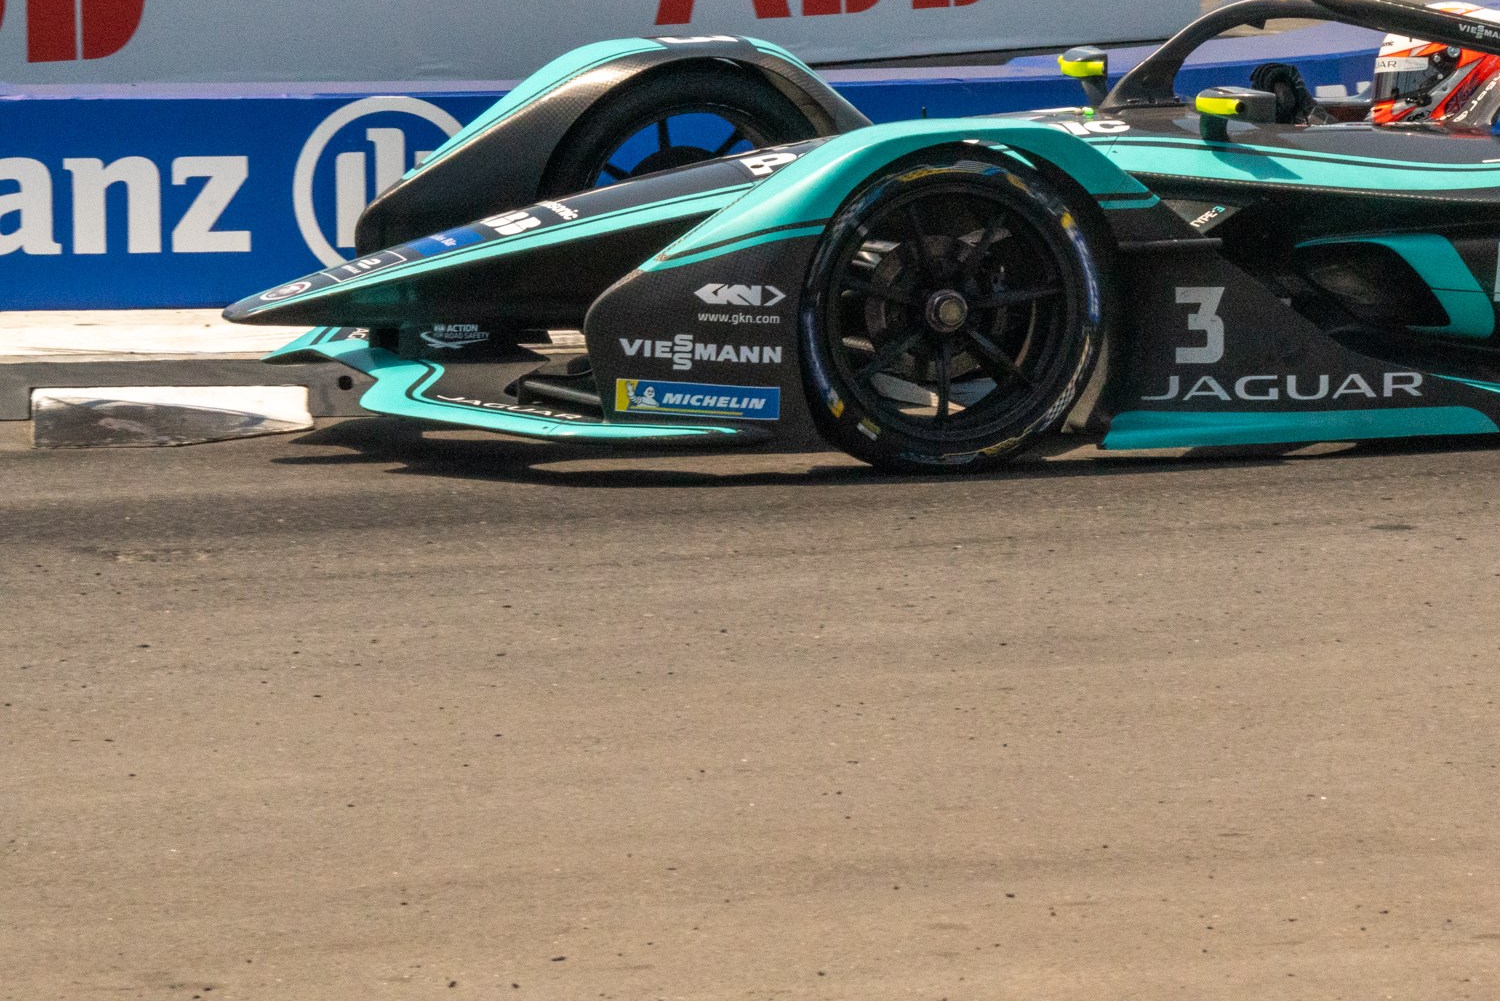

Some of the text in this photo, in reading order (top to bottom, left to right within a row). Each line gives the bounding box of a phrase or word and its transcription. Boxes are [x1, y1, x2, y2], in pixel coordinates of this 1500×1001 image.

[0, 156, 251, 256] anz
[446, 324, 479, 332] ACTION
[697, 313, 781, 325] www.gkn.com
[1175, 286, 1225, 364] 3
[464, 331, 490, 339] SAFETY
[619, 334, 783, 370] VIESSMANN
[1141, 372, 1425, 401] JAGUAR
[437, 394, 582, 420] JAGUAR
[662, 392, 767, 410] MICHELIN
